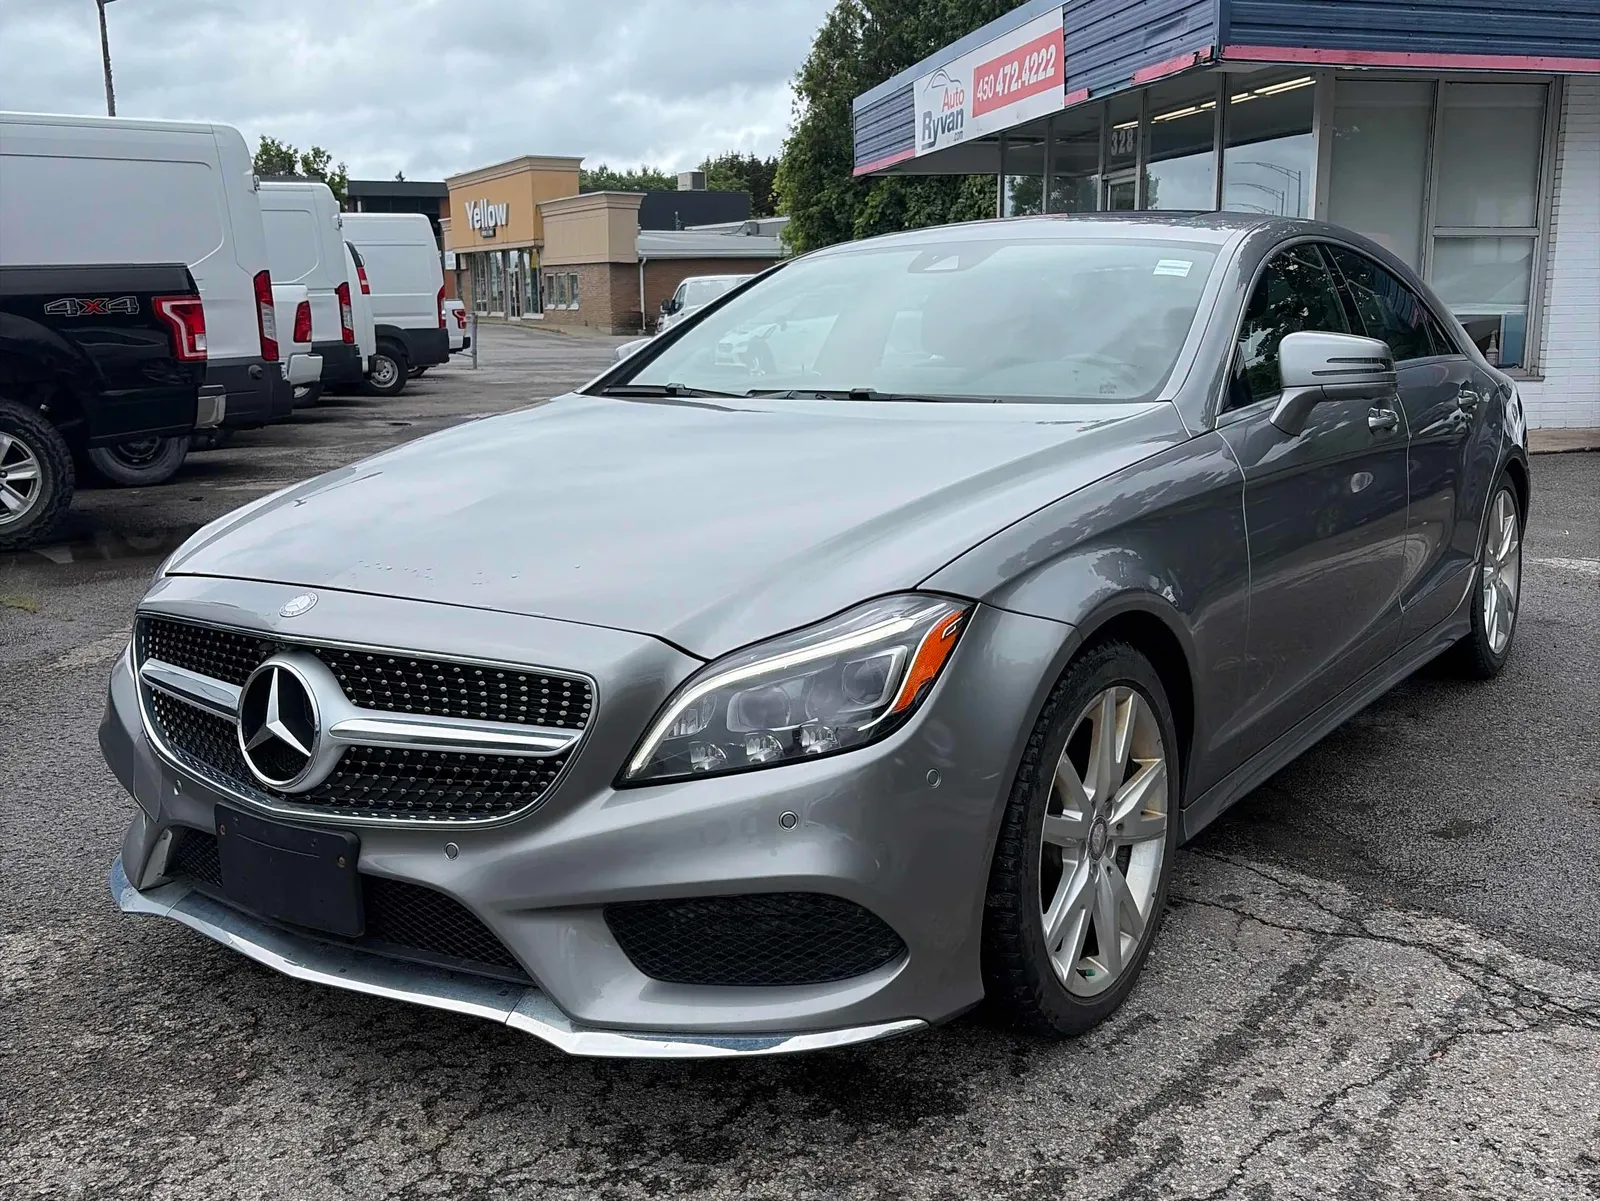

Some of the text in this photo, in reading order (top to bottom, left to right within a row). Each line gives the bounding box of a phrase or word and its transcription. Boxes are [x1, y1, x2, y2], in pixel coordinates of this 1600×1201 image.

[977, 44, 1056, 101] 450 472.4222
[942, 87, 964, 112] Auto
[921, 108, 964, 150] Ryvan
[1111, 129, 1133, 156] 328
[465, 198, 508, 230] Yellow
